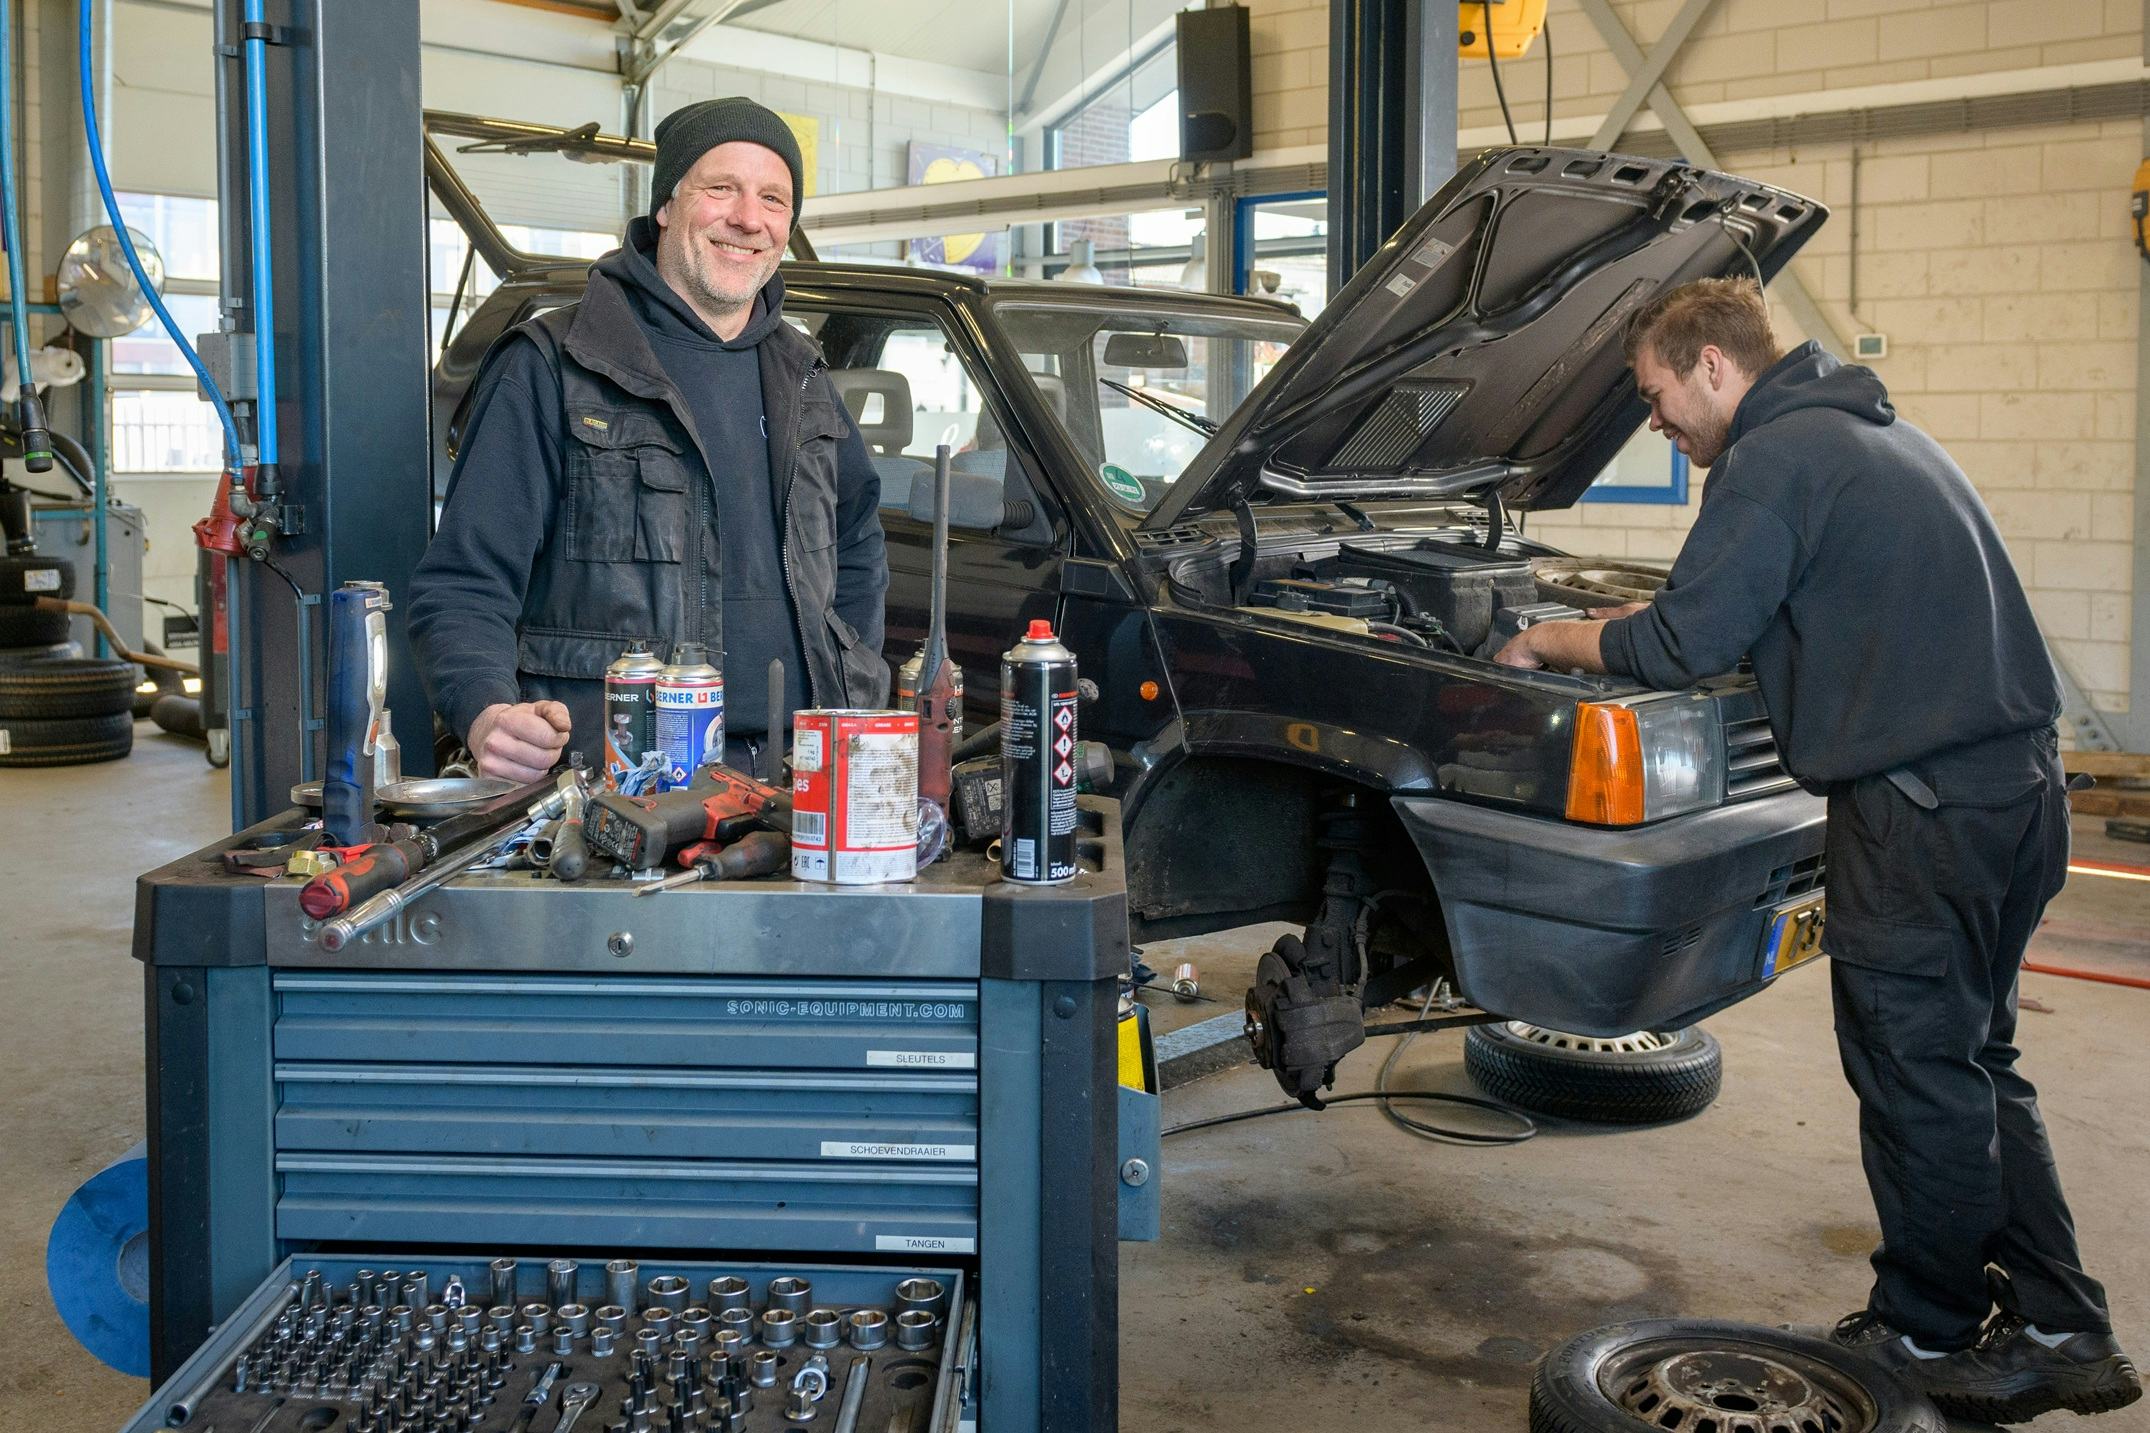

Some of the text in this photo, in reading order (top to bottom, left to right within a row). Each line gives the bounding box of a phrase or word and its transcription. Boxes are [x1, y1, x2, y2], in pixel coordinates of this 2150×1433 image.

[605, 692, 640, 702] ERNER
[793, 778, 810, 793] es
[1050, 866, 1069, 879] 500
[727, 1000, 965, 1018] SONIC-EQUIPMENT.COM
[895, 1053, 946, 1064] SLEUTELS
[850, 1145, 946, 1156] SCHOEVENDRAAIER
[905, 1239, 945, 1249] TANGEN
